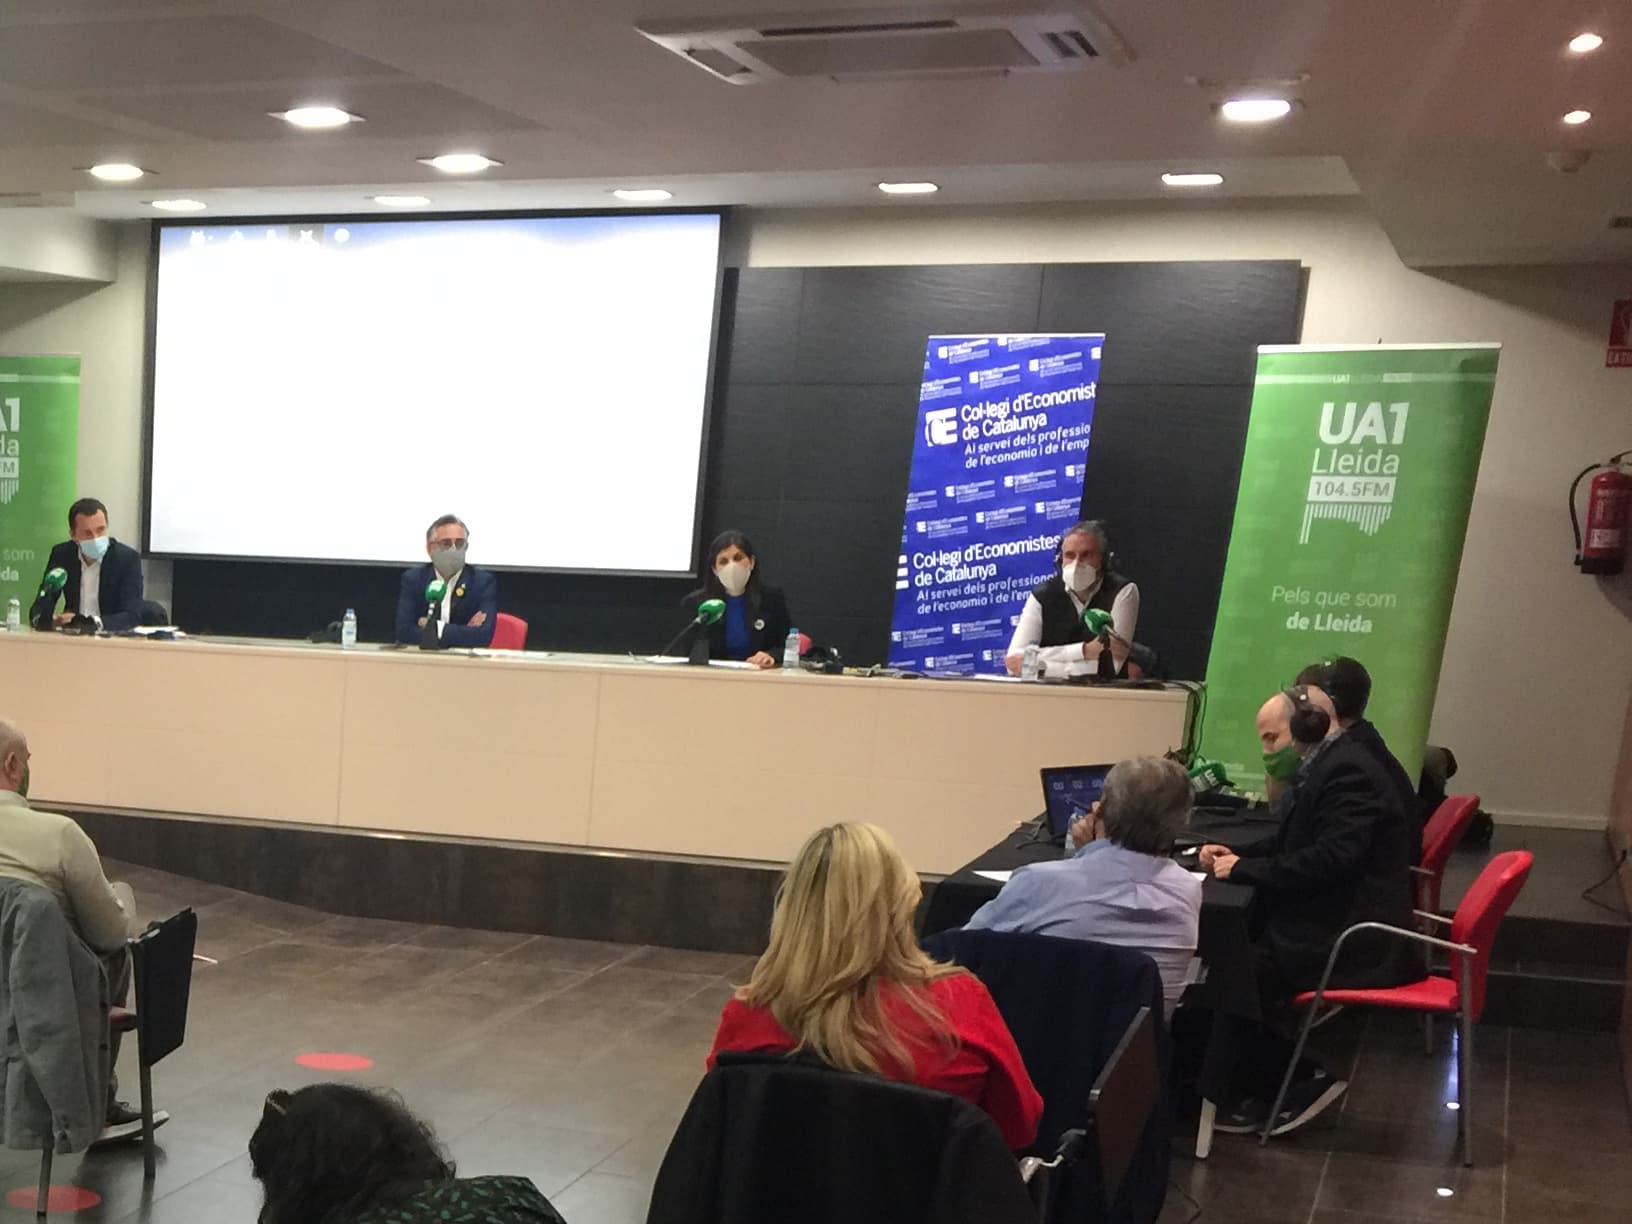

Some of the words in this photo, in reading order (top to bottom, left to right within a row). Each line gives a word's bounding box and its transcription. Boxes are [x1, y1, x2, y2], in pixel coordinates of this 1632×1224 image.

[962, 424, 980, 441] de
[982, 412, 1048, 438] Catalunya
[1319, 401, 1410, 445] UA1
[978, 437, 1011, 454] servei
[1013, 431, 1036, 448] dels
[965, 457, 979, 470] de
[1045, 441, 1059, 454] de
[1311, 448, 1401, 475] Lleida
[1314, 481, 1391, 497] 104.5FM
[3, 549, 35, 561] som
[915, 571, 933, 588] de
[935, 563, 998, 585] Catalunya
[931, 584, 962, 601] servei
[964, 578, 986, 595] dels
[1271, 585, 1311, 605] Pels
[1315, 590, 1351, 609] que
[1354, 592, 1398, 608] som
[917, 602, 932, 615] de
[996, 592, 1009, 604] de
[1286, 611, 1310, 630] de
[1314, 612, 1374, 633] Lleida
